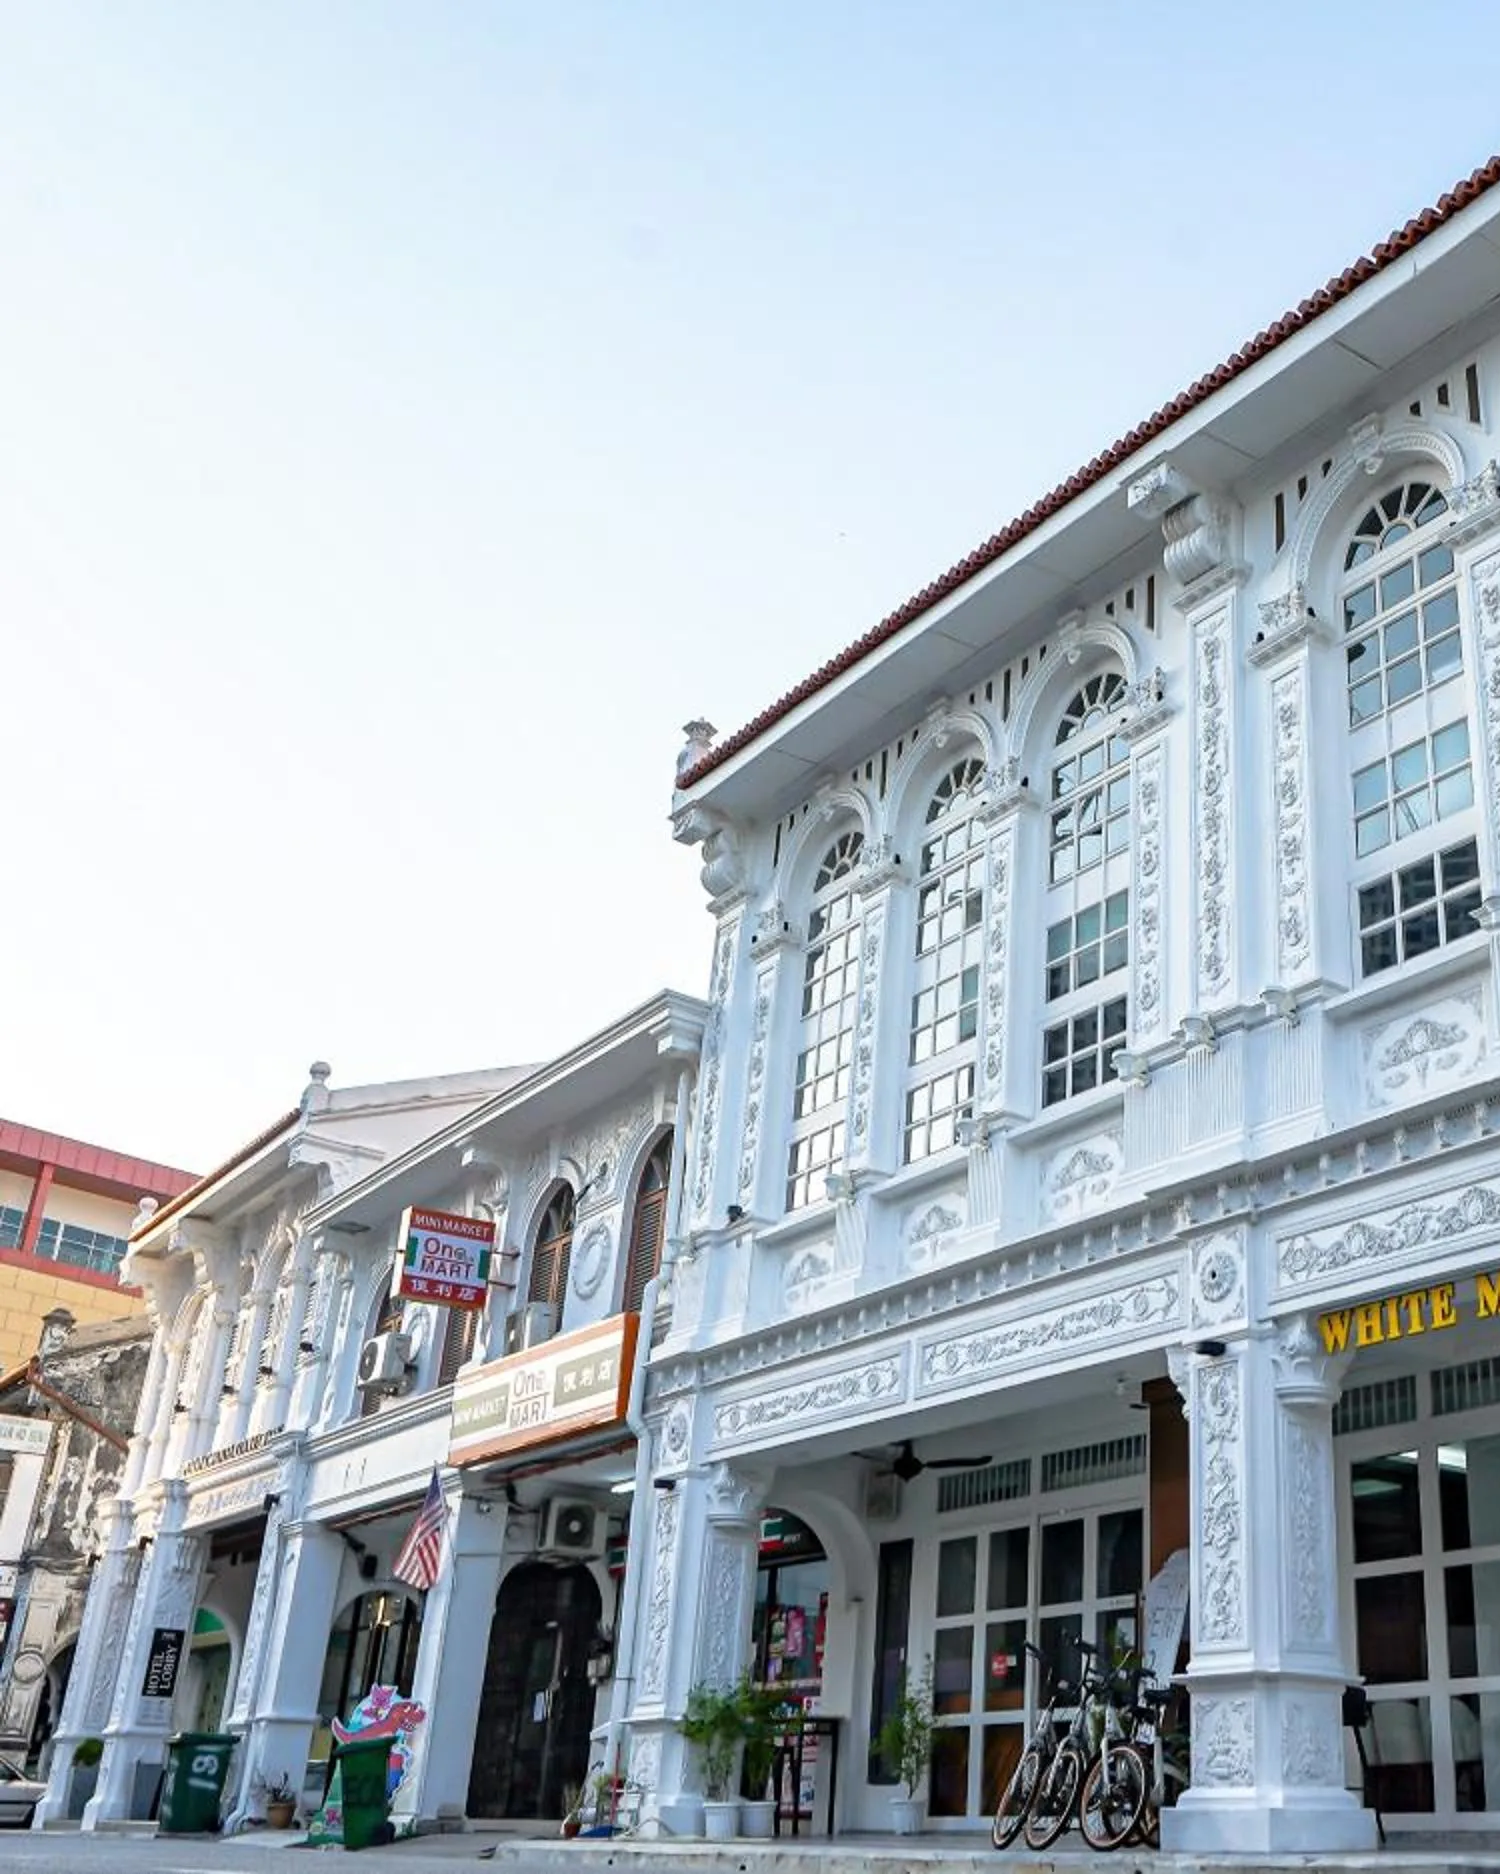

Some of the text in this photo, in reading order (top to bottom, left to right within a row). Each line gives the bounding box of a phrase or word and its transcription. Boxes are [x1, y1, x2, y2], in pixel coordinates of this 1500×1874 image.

[415, 1214, 491, 1240] MINI MARKET
[424, 1237, 466, 1260] One
[422, 1257, 474, 1279] MART
[1318, 1282, 1457, 1356] WHITE
[147, 1652, 165, 1695] HOTEL
[160, 1644, 177, 1690] LOBBY
